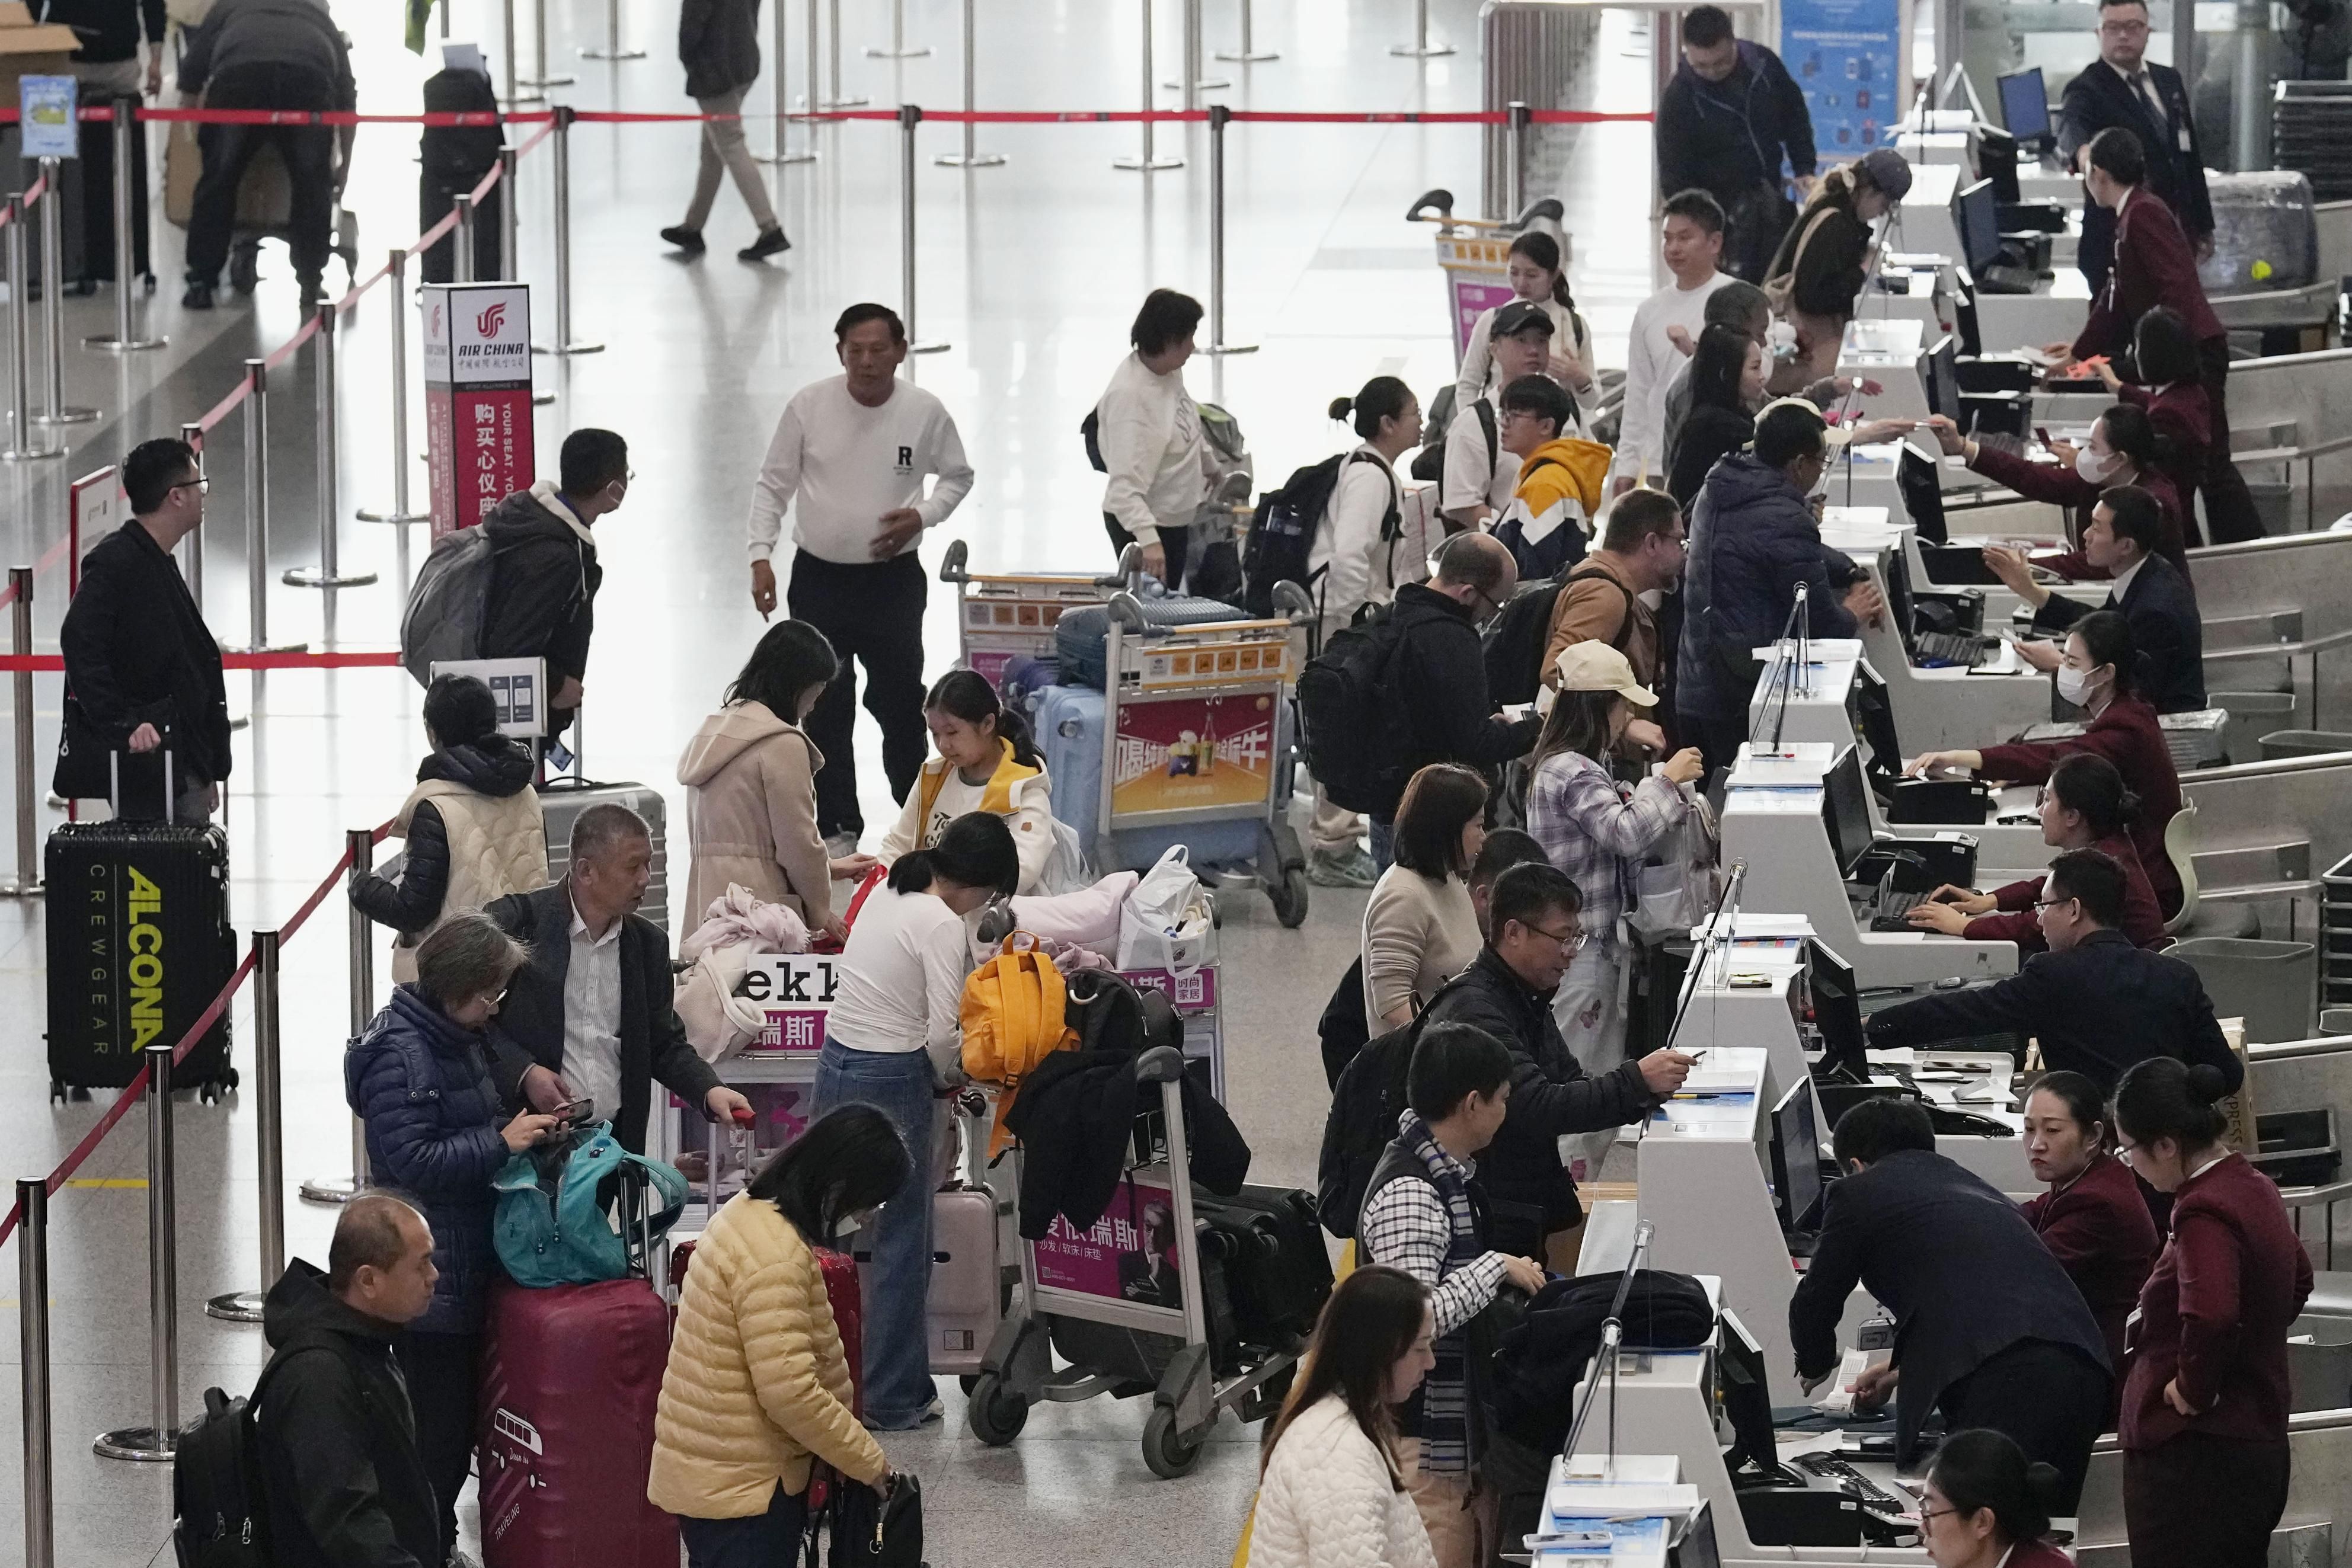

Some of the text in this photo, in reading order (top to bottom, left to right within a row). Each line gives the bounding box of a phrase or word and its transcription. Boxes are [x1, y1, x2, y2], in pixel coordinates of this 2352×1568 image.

[459, 345, 481, 356] AIR
[484, 343, 524, 356] CHINA
[503, 402, 512, 436] YOUR
[504, 437, 513, 468] SEAT
[899, 446, 912, 466] R
[129, 865, 163, 1053] ALCONA
[1178, 977, 1200, 988] 时尚
[1178, 989, 1200, 1000] 家居
[495, 1503, 520, 1541] TRAVELING
